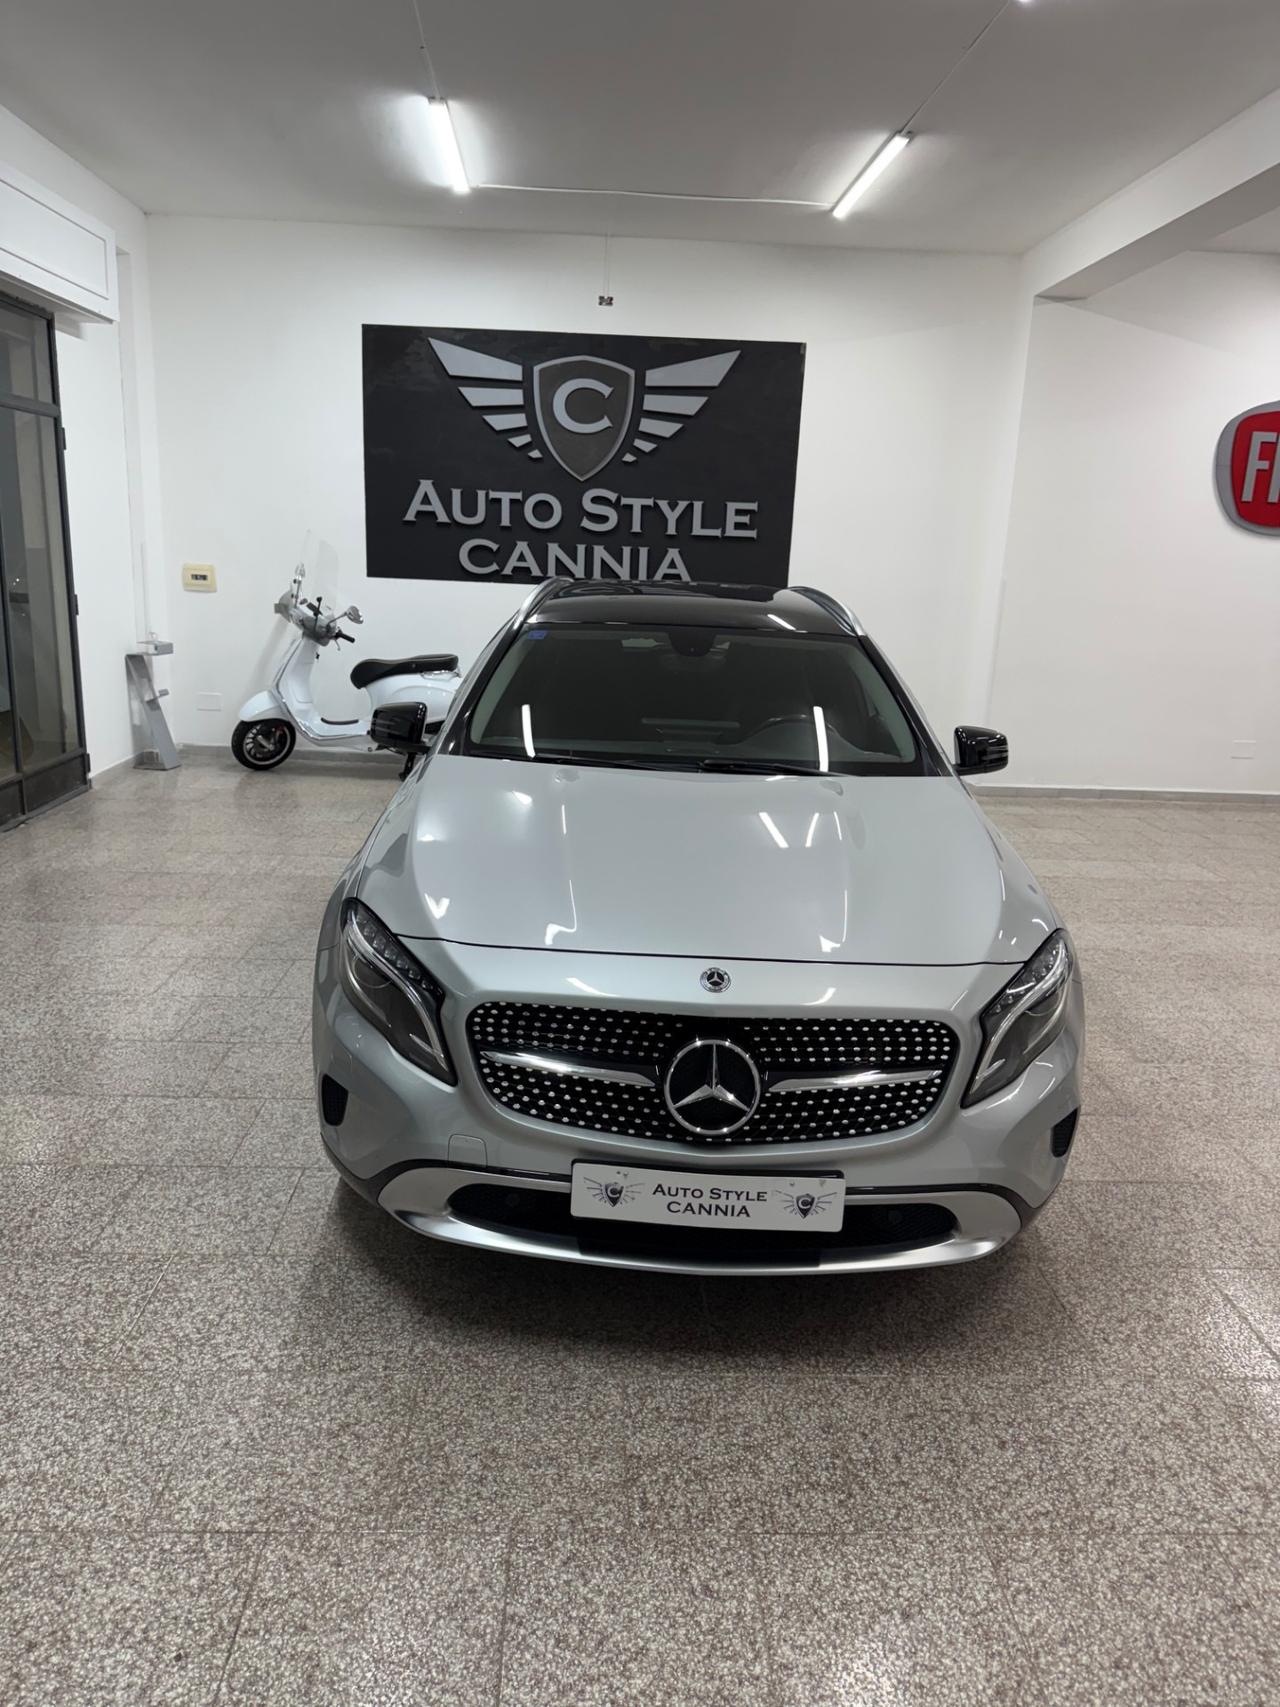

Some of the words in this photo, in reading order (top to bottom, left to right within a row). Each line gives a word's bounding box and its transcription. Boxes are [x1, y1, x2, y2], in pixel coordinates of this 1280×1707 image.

[553, 378, 613, 434] C
[403, 479, 562, 530] AUTO
[580, 488, 758, 539] STYLE
[458, 538, 691, 582] CANNIA
[652, 1183, 704, 1199] AUTO
[709, 1188, 768, 1202] STYLE
[667, 1201, 751, 1217] CANNIA
